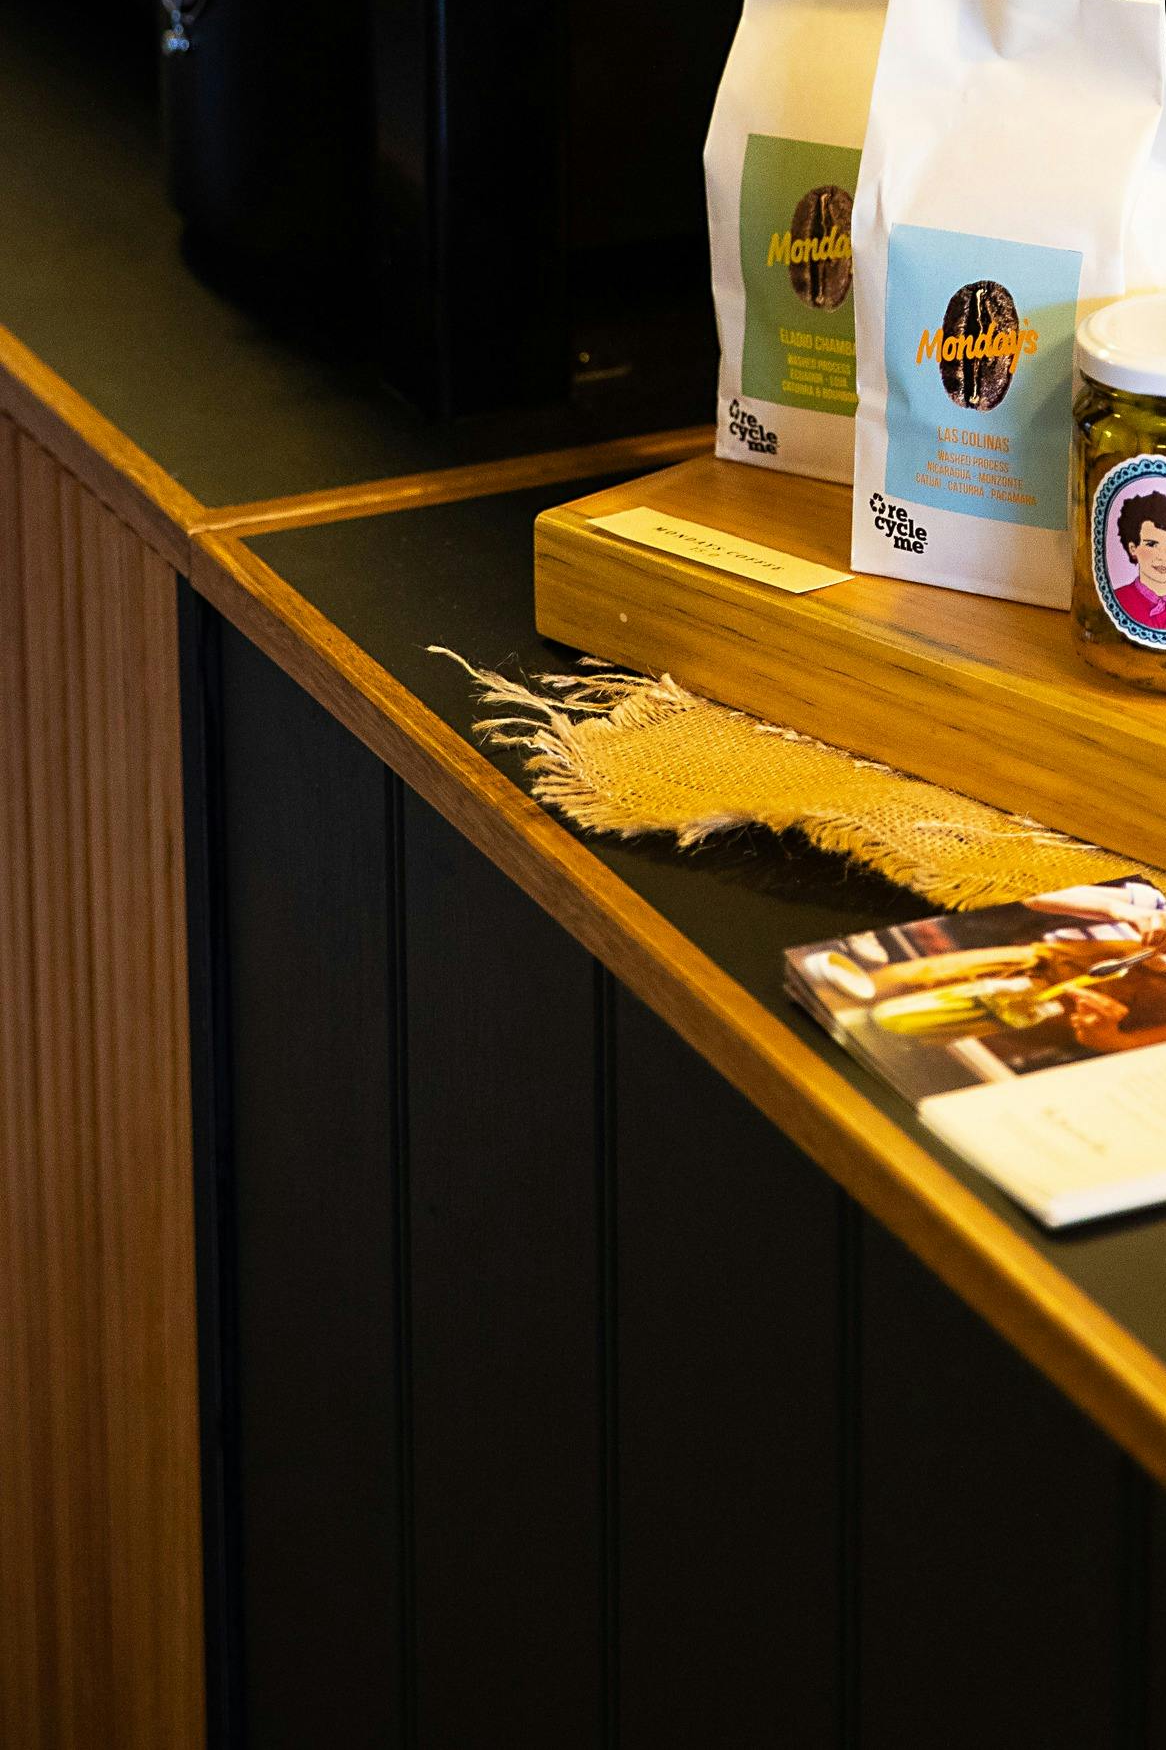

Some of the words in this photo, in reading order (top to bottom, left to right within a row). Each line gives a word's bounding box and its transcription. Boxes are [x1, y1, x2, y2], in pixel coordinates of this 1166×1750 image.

[767, 224, 853, 267] Monda
[916, 318, 1038, 374] Monday's
[741, 411, 757, 427] re
[729, 422, 777, 444] cycle
[937, 426, 959, 443] LAS
[961, 430, 1010, 453] COLINAS
[747, 440, 777, 454] me
[937, 450, 971, 466] WASHED
[972, 457, 1009, 473] PROCESS
[887, 504, 908, 522] re
[874, 515, 927, 542] cycle
[893, 536, 925, 554] me
